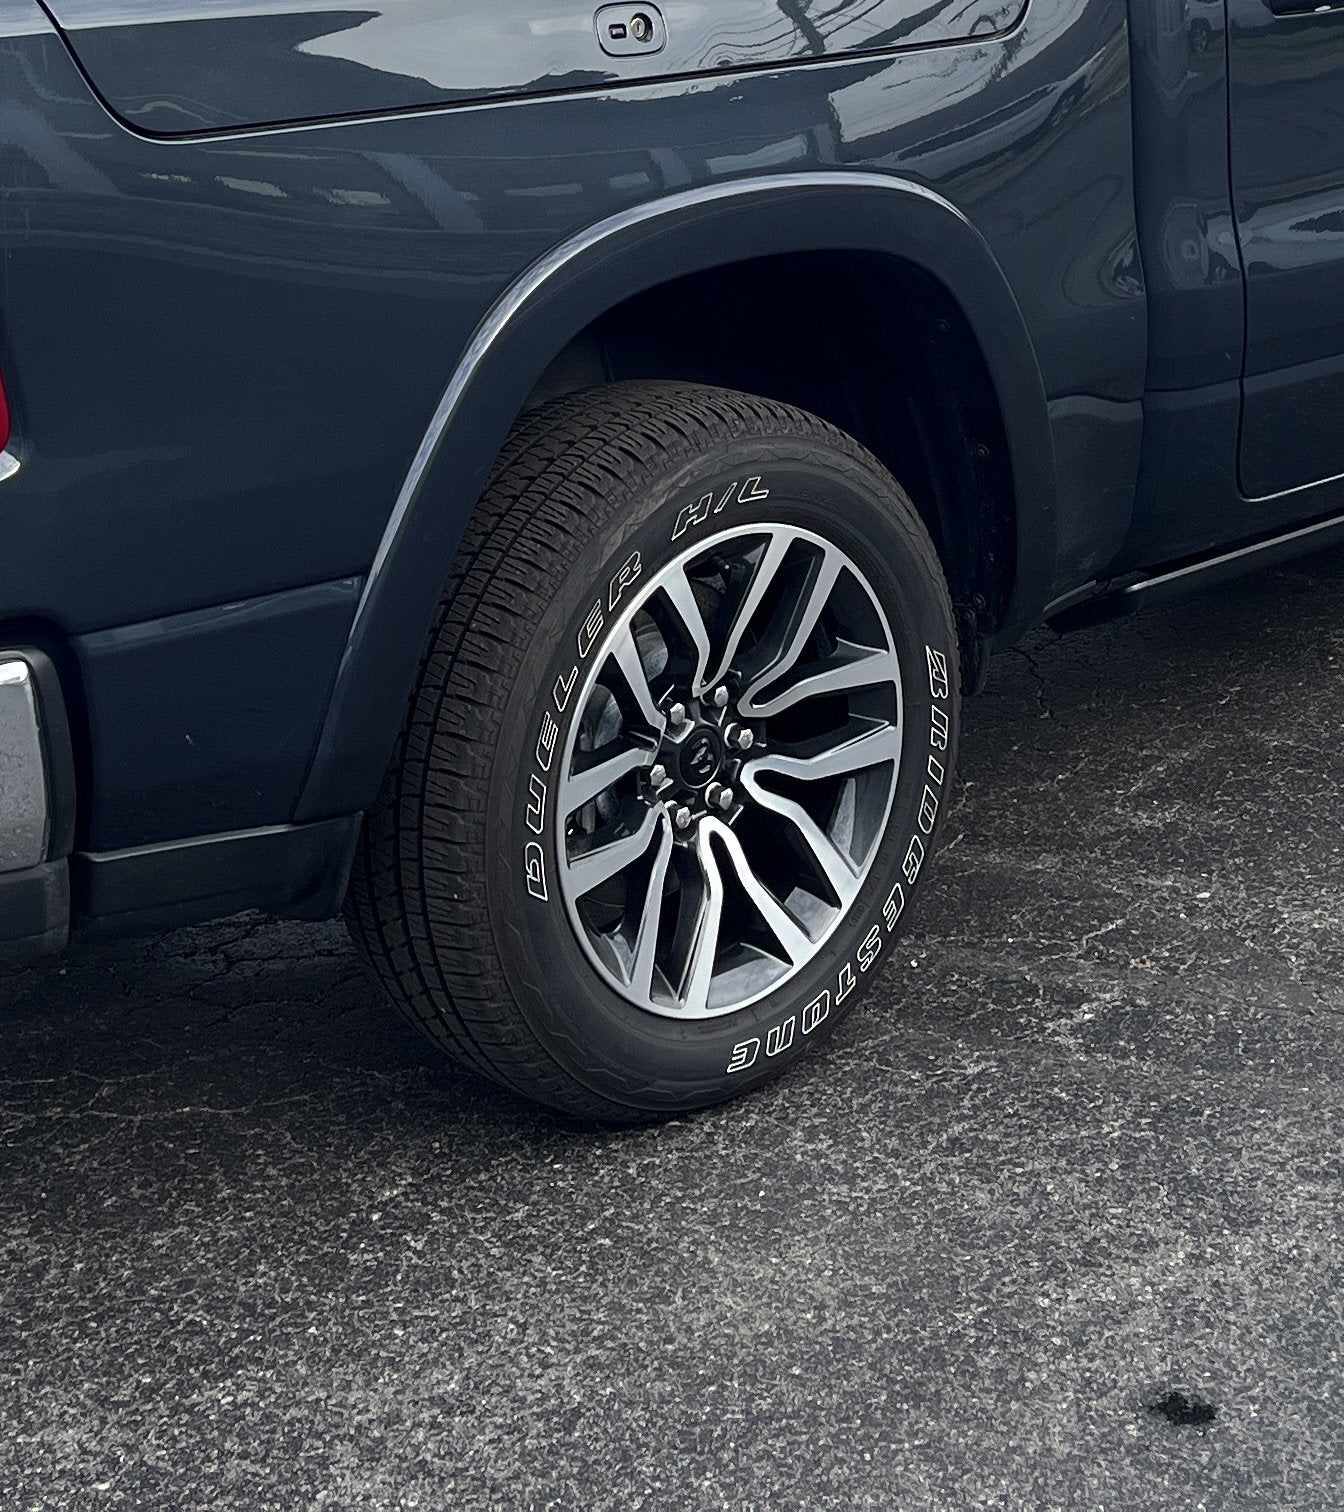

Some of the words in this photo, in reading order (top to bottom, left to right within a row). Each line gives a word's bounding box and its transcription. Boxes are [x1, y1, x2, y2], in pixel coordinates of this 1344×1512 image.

[522, 549, 643, 902] DUELER
[670, 476, 770, 542] H/L
[726, 645, 950, 1075] BRIDGESTONE
